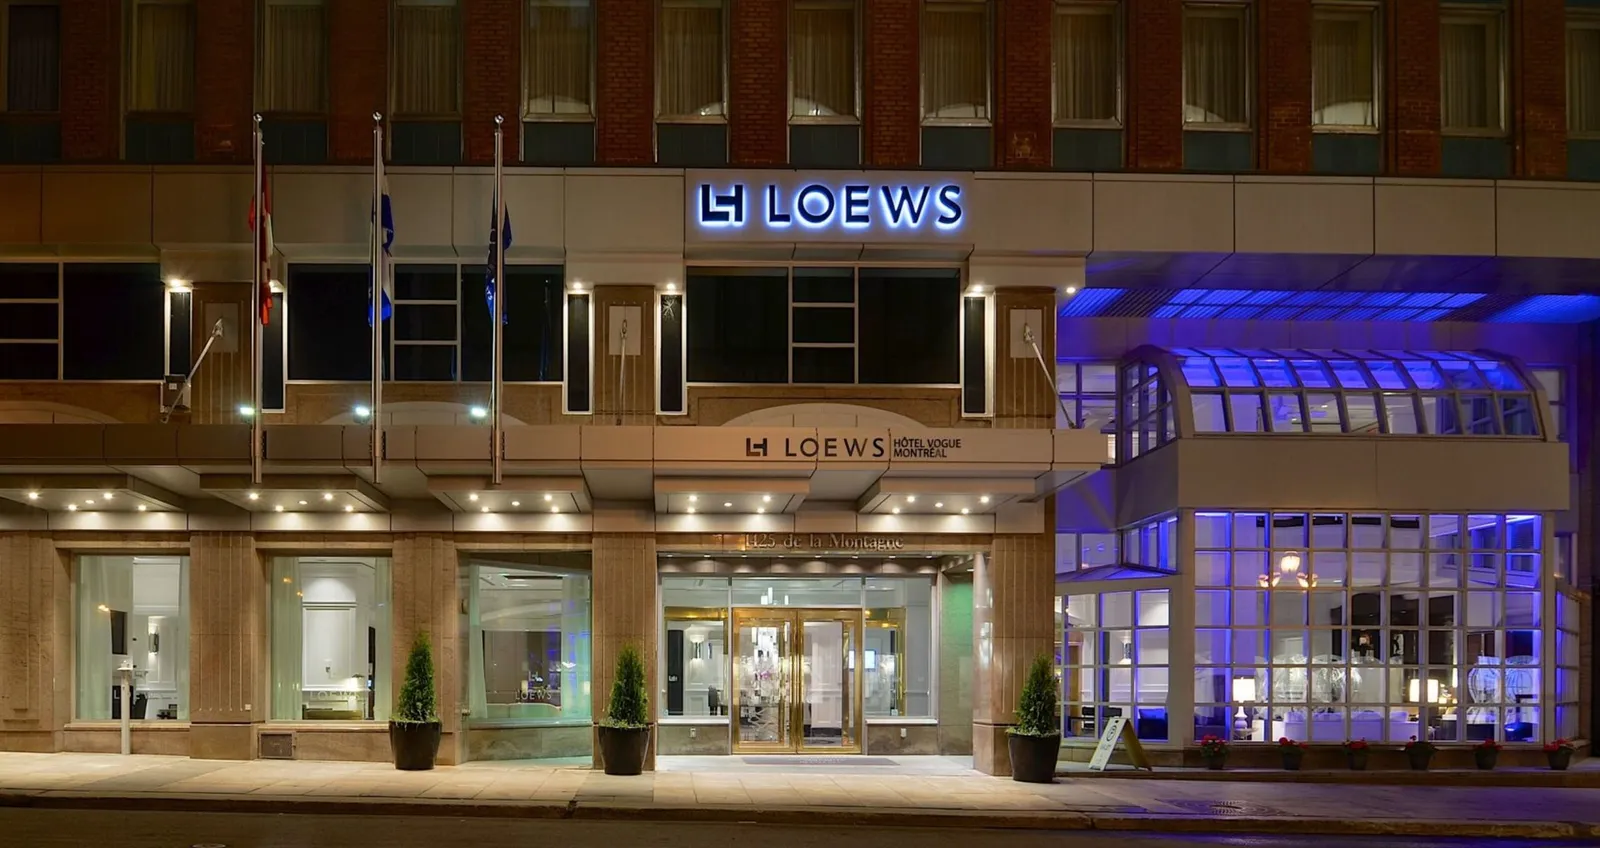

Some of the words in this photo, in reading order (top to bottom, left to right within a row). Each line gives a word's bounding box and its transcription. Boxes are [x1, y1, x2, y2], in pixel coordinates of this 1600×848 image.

[768, 184, 962, 224] LOEWS
[785, 437, 885, 457] LOEWS
[893, 436, 925, 449] HÔTEL
[927, 438, 961, 449] VOGUE
[893, 447, 948, 458] MONTRÉAL
[745, 533, 776, 549] 1425
[783, 533, 801, 548] de
[810, 534, 823, 548] la
[828, 533, 904, 551] Montagne
[515, 691, 551, 700] LOEWS
